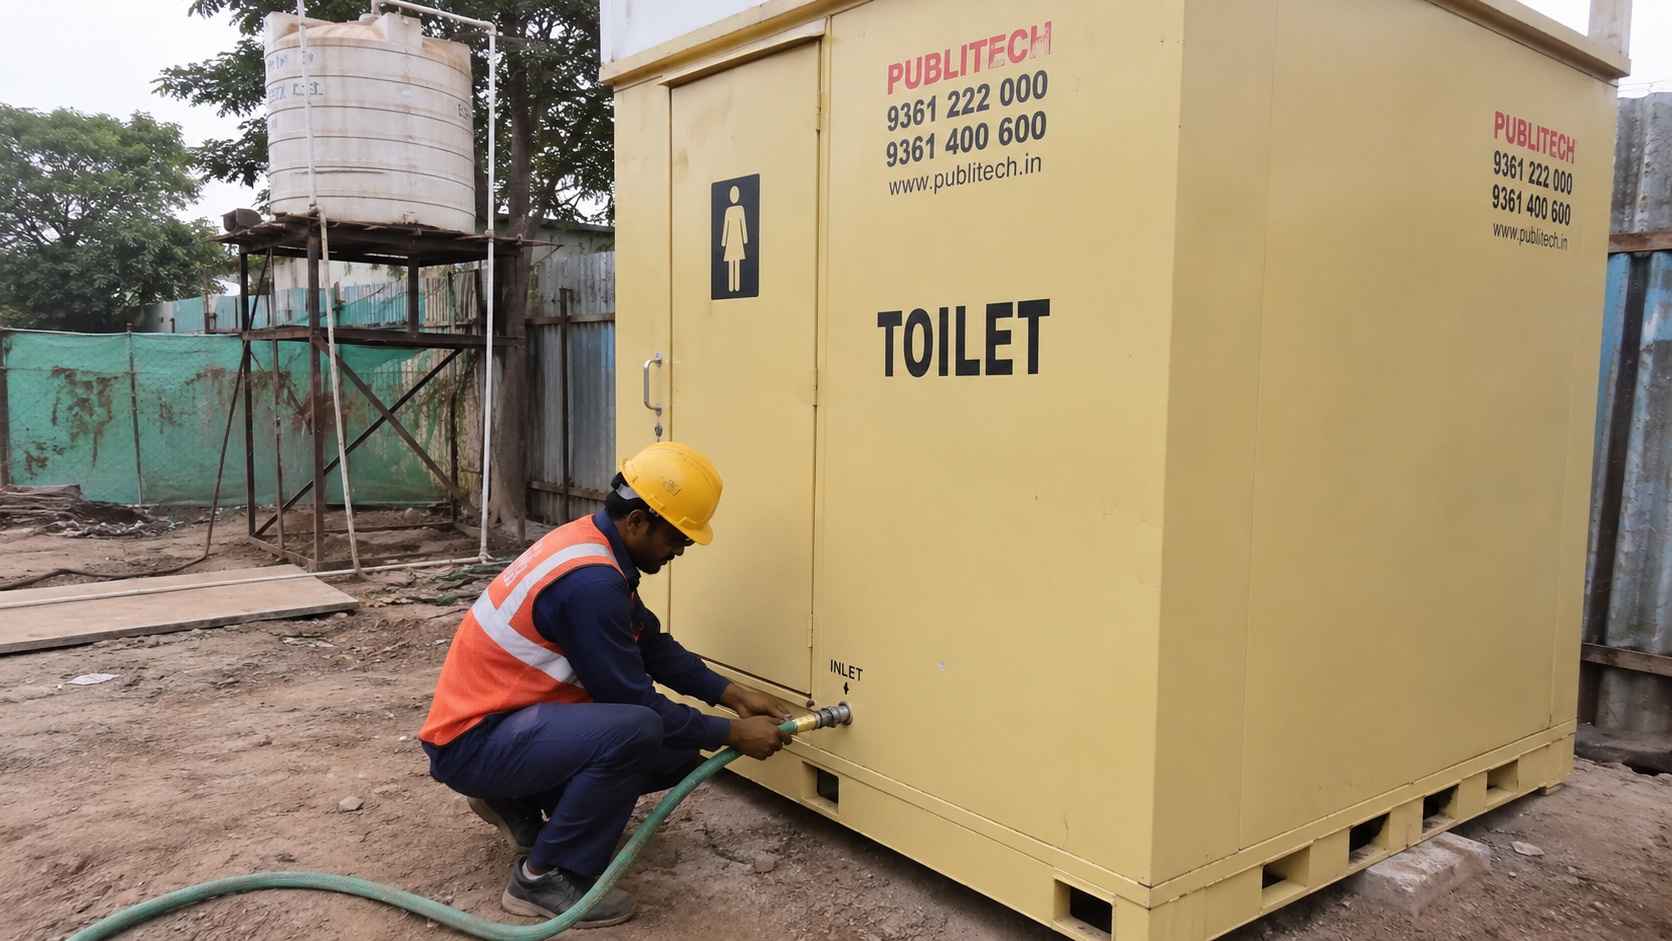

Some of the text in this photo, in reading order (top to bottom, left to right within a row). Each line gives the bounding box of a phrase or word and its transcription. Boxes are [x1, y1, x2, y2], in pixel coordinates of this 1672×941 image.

[888, 20, 1052, 95] PUBLITECH
[887, 70, 1048, 132] 9361 222 000
[886, 110, 1047, 167] 9361 400 600
[1495, 111, 1576, 164] PUBLITECH
[889, 153, 1042, 196] www.publitech.in
[1494, 151, 1572, 194] 9361 222 000
[1492, 184, 1571, 225] 9361 400 600
[1493, 223, 1568, 251] www.publitech.in
[877, 298, 1051, 377] TOILET
[831, 659, 863, 681] INLET
